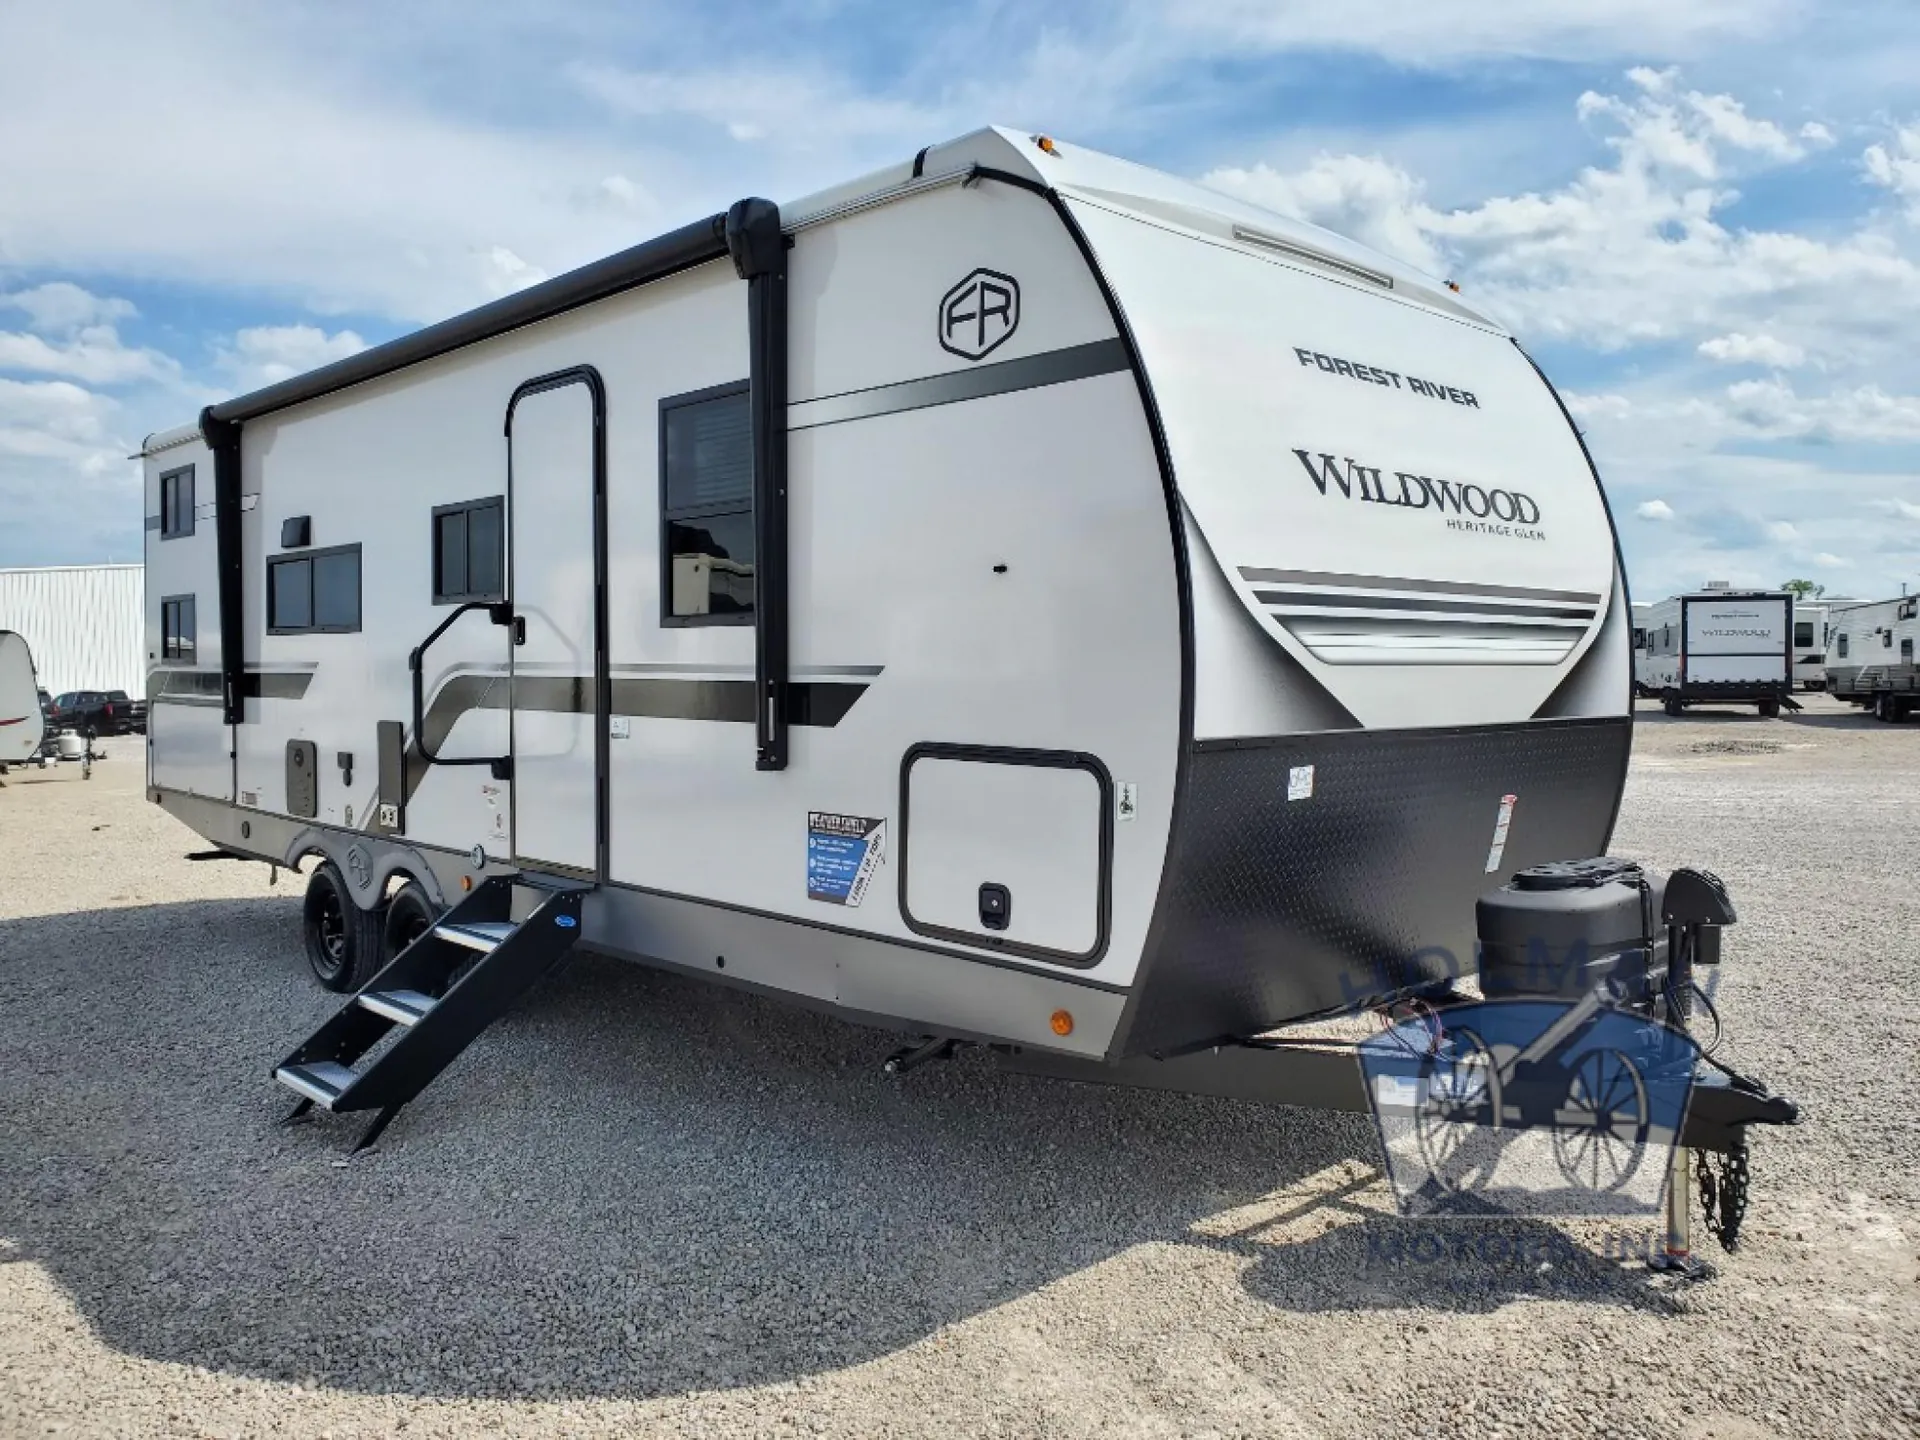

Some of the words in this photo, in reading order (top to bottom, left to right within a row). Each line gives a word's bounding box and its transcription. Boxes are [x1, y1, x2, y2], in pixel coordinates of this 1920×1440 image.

[1291, 346, 1402, 389] FOREST
[1406, 375, 1482, 409] RIVER
[1447, 518, 1512, 537] HERITAGE
[1514, 527, 1547, 541] GLEN
